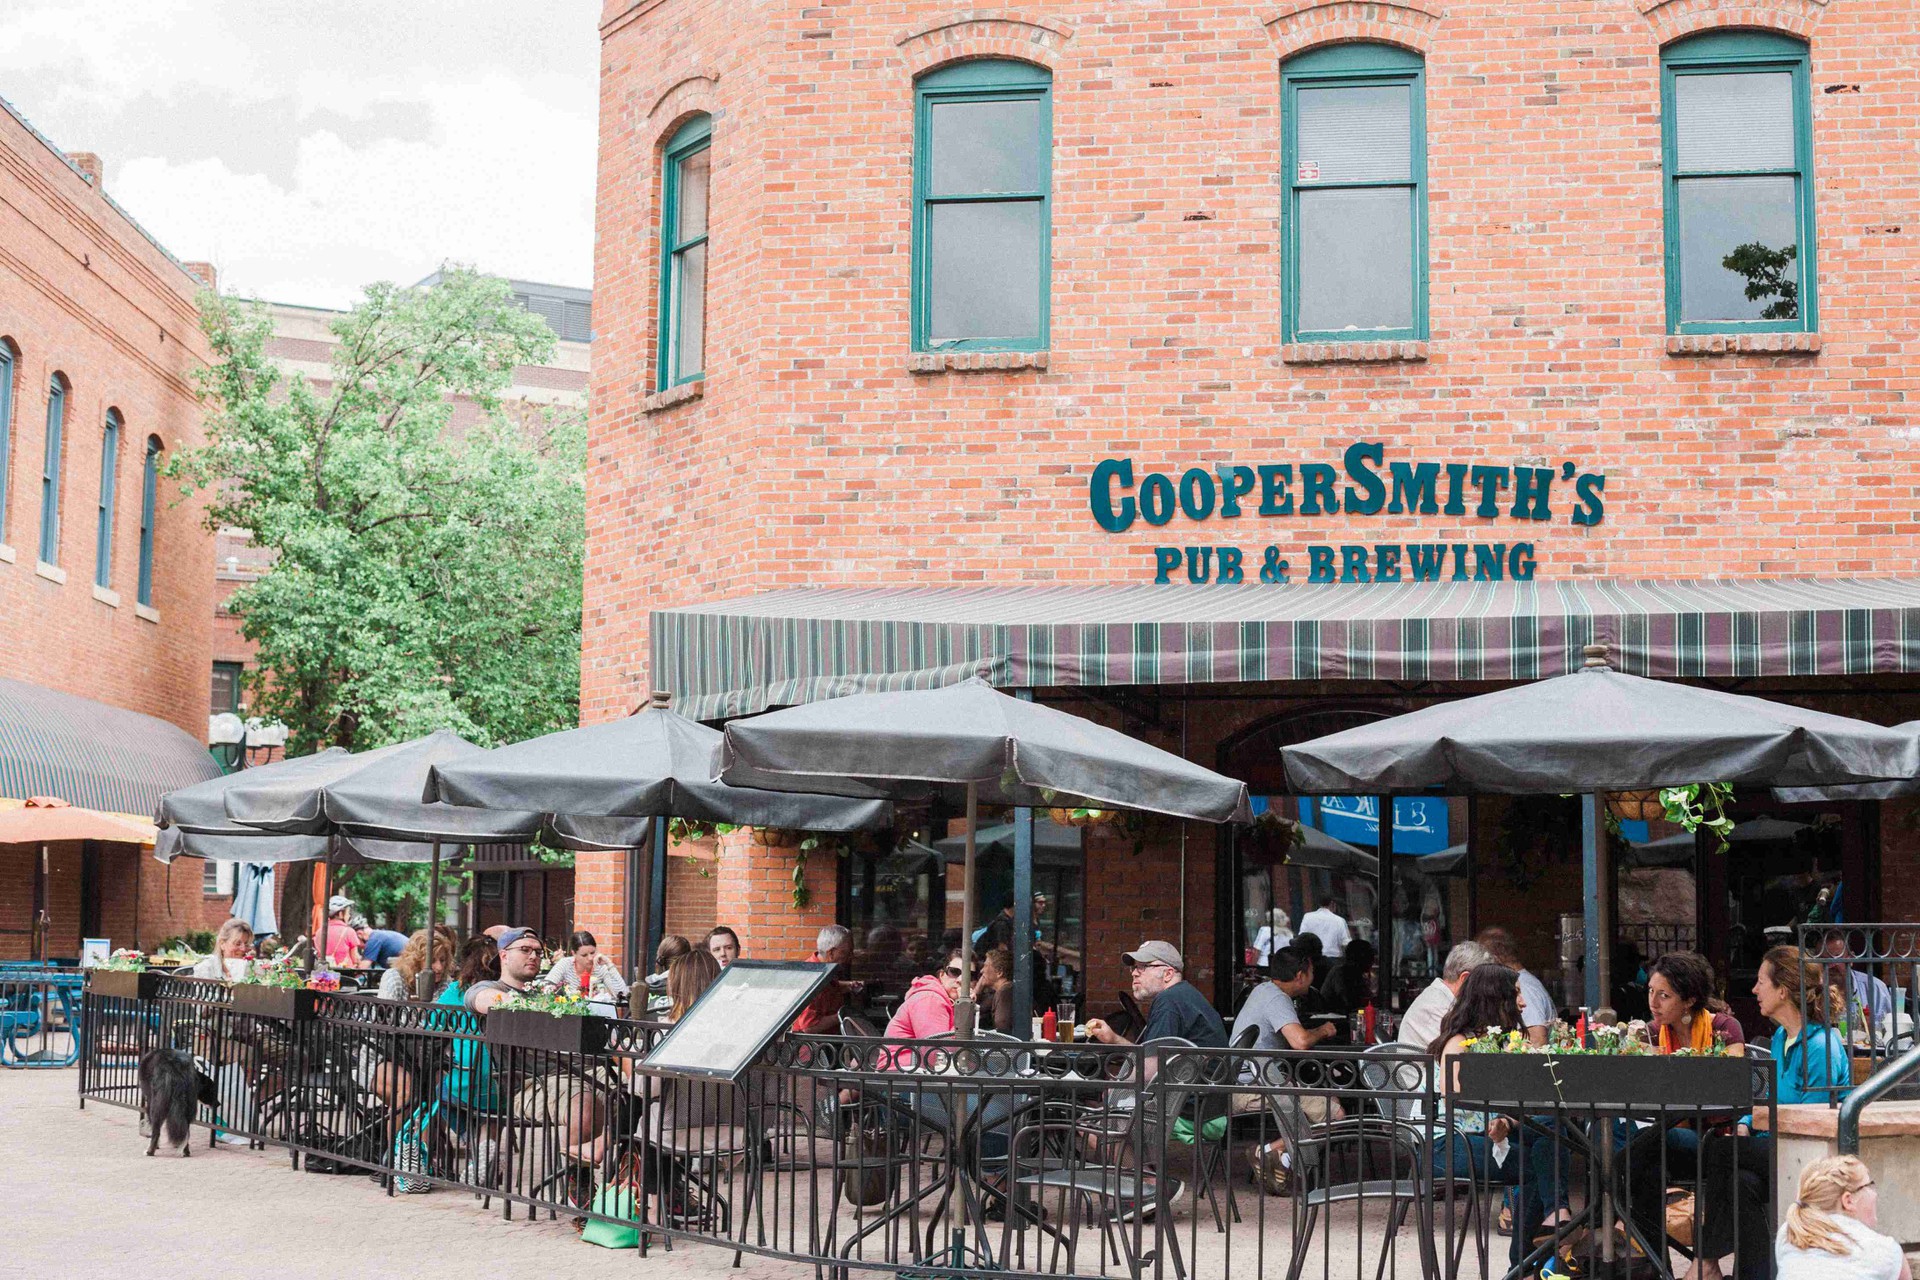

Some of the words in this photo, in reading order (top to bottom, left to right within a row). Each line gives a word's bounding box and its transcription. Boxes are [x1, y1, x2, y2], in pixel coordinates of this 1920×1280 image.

[1090, 441, 1606, 533] COOPERSMITH'S
[1154, 546, 1244, 585] PUB
[1259, 545, 1290, 585] &
[1307, 541, 1538, 584] BREWING
